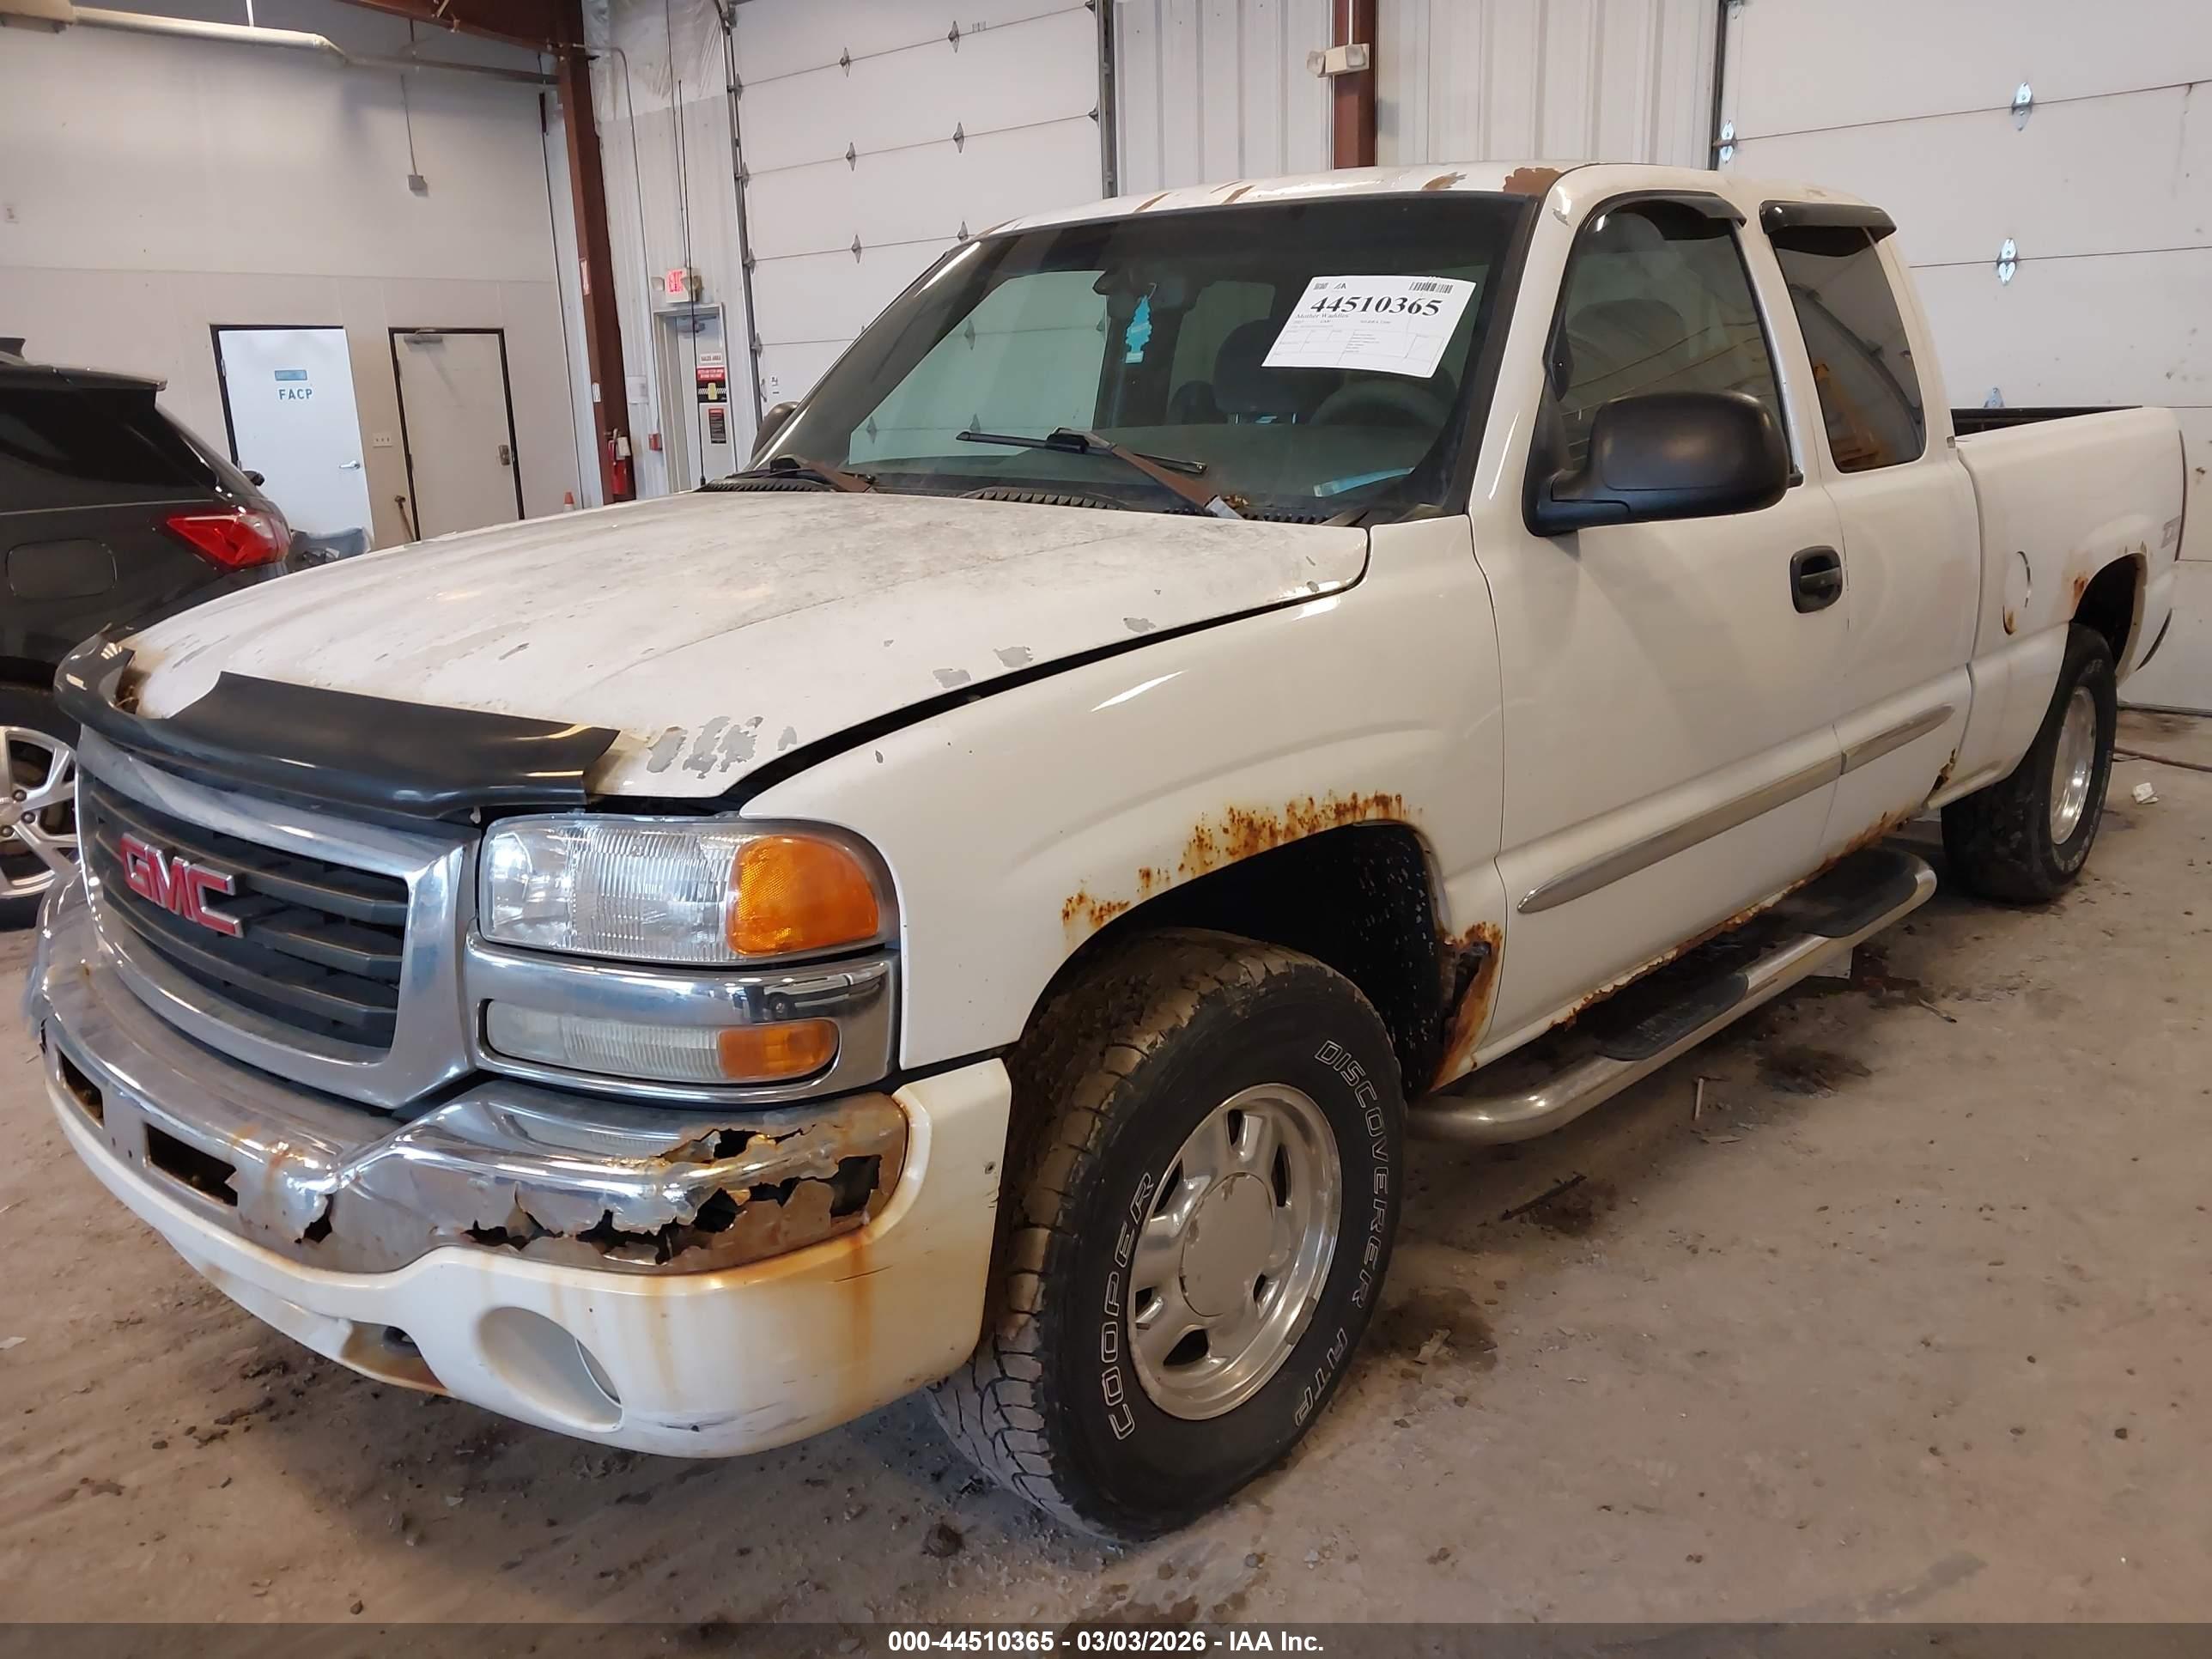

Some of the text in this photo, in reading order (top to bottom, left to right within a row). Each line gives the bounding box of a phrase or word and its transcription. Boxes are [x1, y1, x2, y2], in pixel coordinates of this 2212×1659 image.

[1310, 295, 1443, 316] 44510365
[278, 388, 313, 400] FACP
[120, 832, 244, 939] GMC
[1314, 1039, 1390, 1310] DISCOVERER
[1100, 1171, 1154, 1441] COOPER
